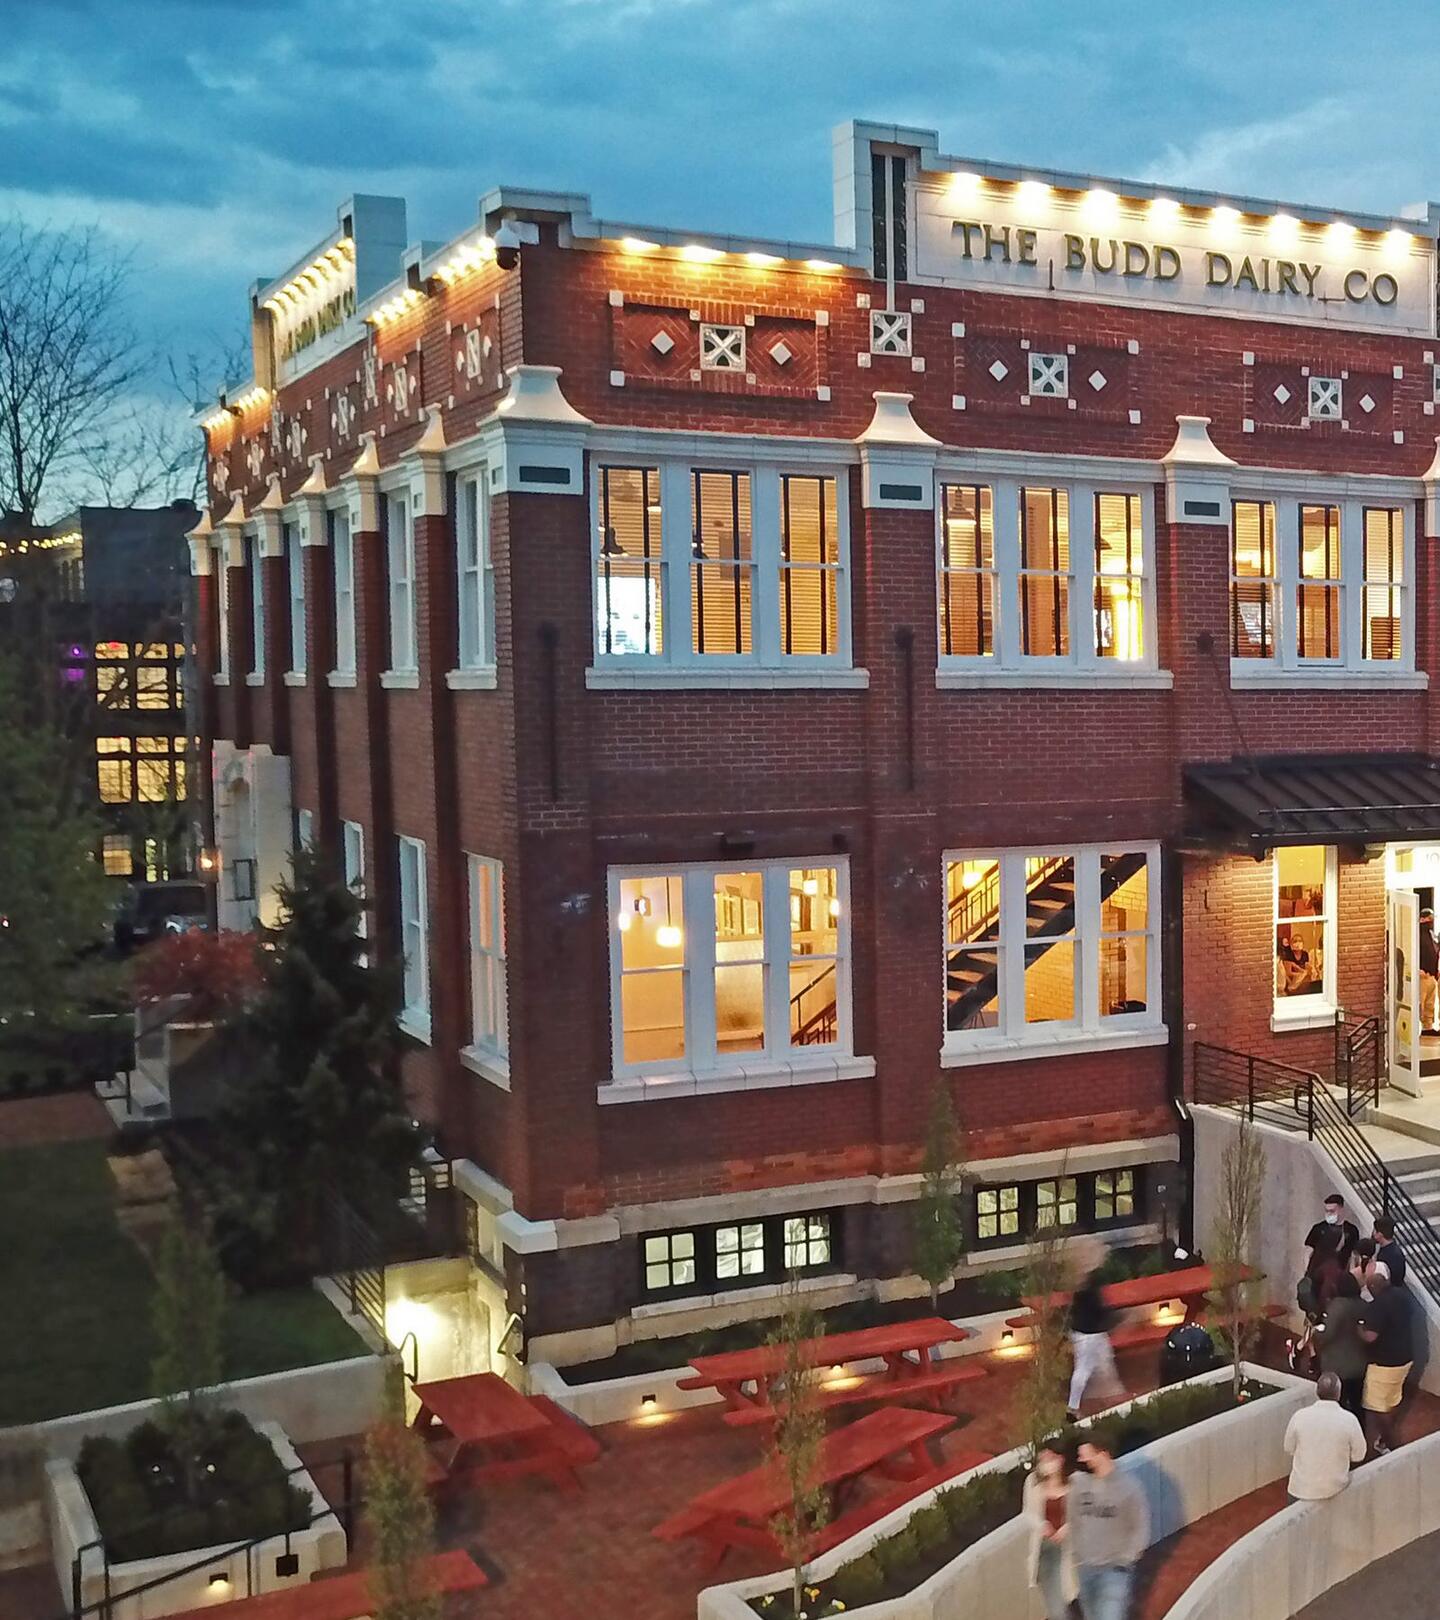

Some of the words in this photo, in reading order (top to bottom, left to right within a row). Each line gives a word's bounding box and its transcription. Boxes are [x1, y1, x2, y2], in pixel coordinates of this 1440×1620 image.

[952, 220, 1037, 265] THE
[1065, 233, 1182, 280] BUDD
[1206, 251, 1321, 297] DAIRY
[1344, 269, 1398, 305] CO
